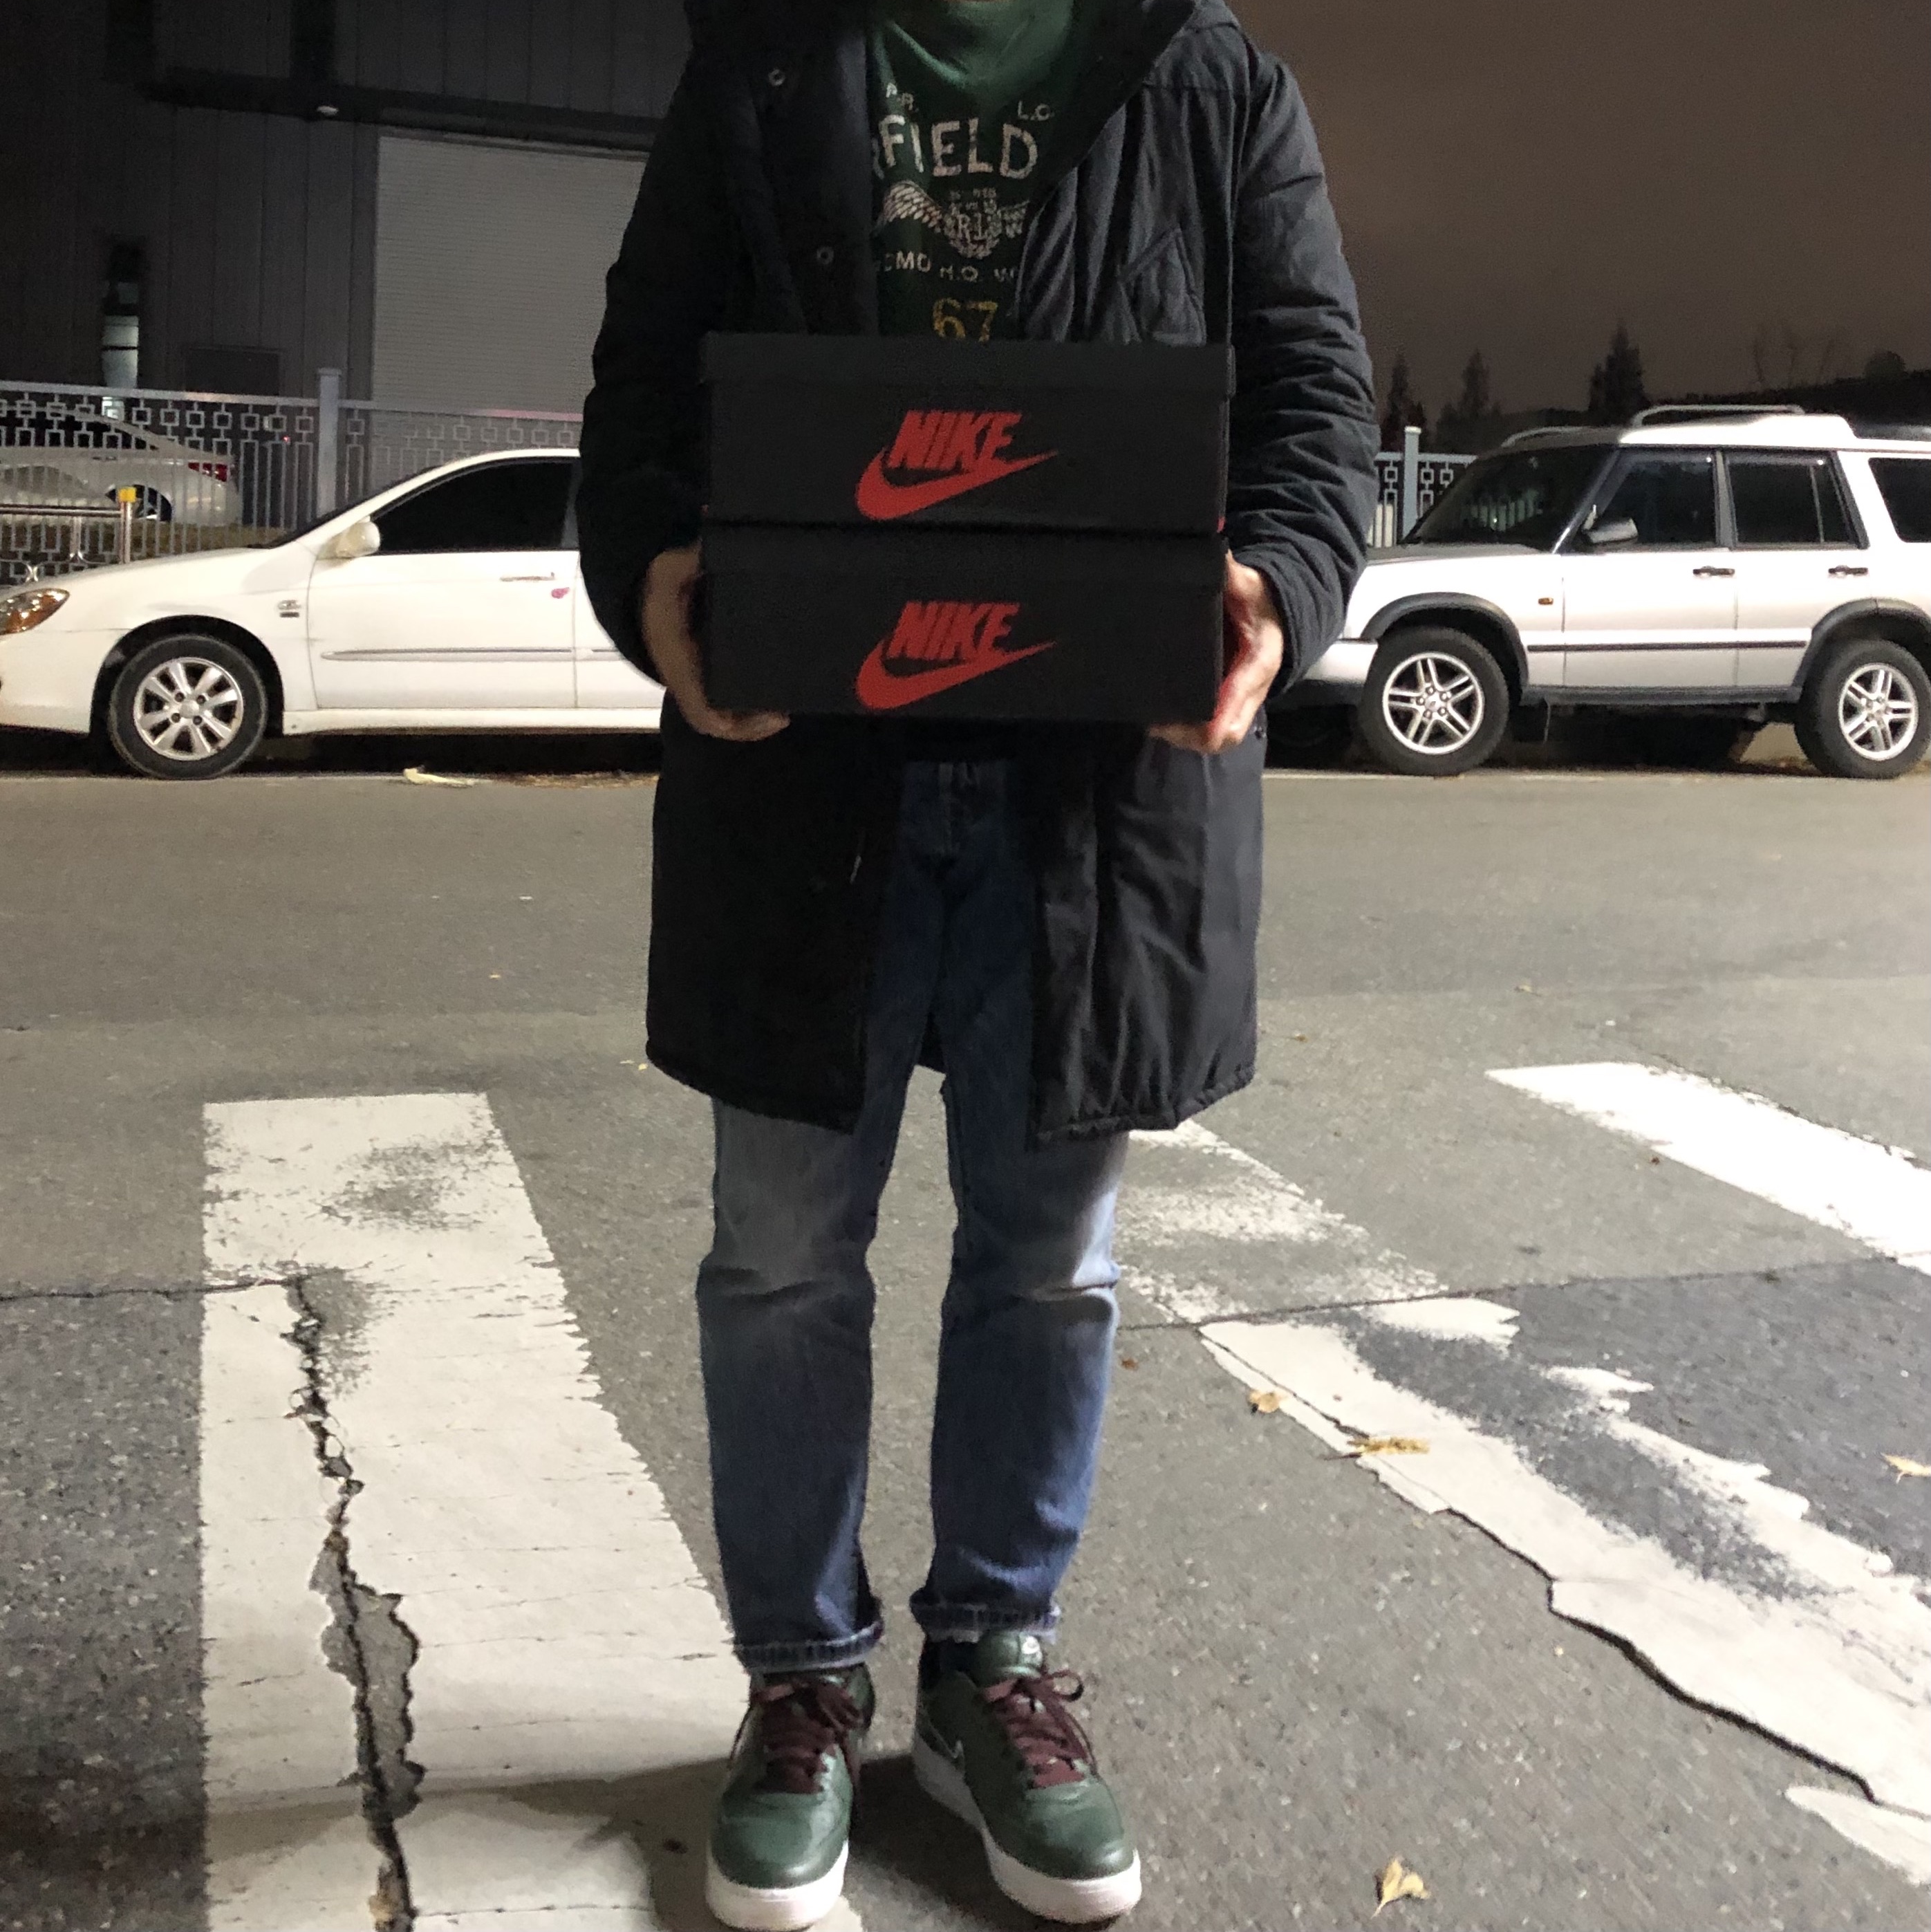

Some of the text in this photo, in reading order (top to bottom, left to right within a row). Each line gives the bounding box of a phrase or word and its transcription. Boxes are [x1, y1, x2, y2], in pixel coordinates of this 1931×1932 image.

[872, 114, 1038, 180] FIELD
[932, 297, 998, 343] 67
[886, 410, 1023, 470] NIKE
[886, 600, 1021, 660] NIKE
